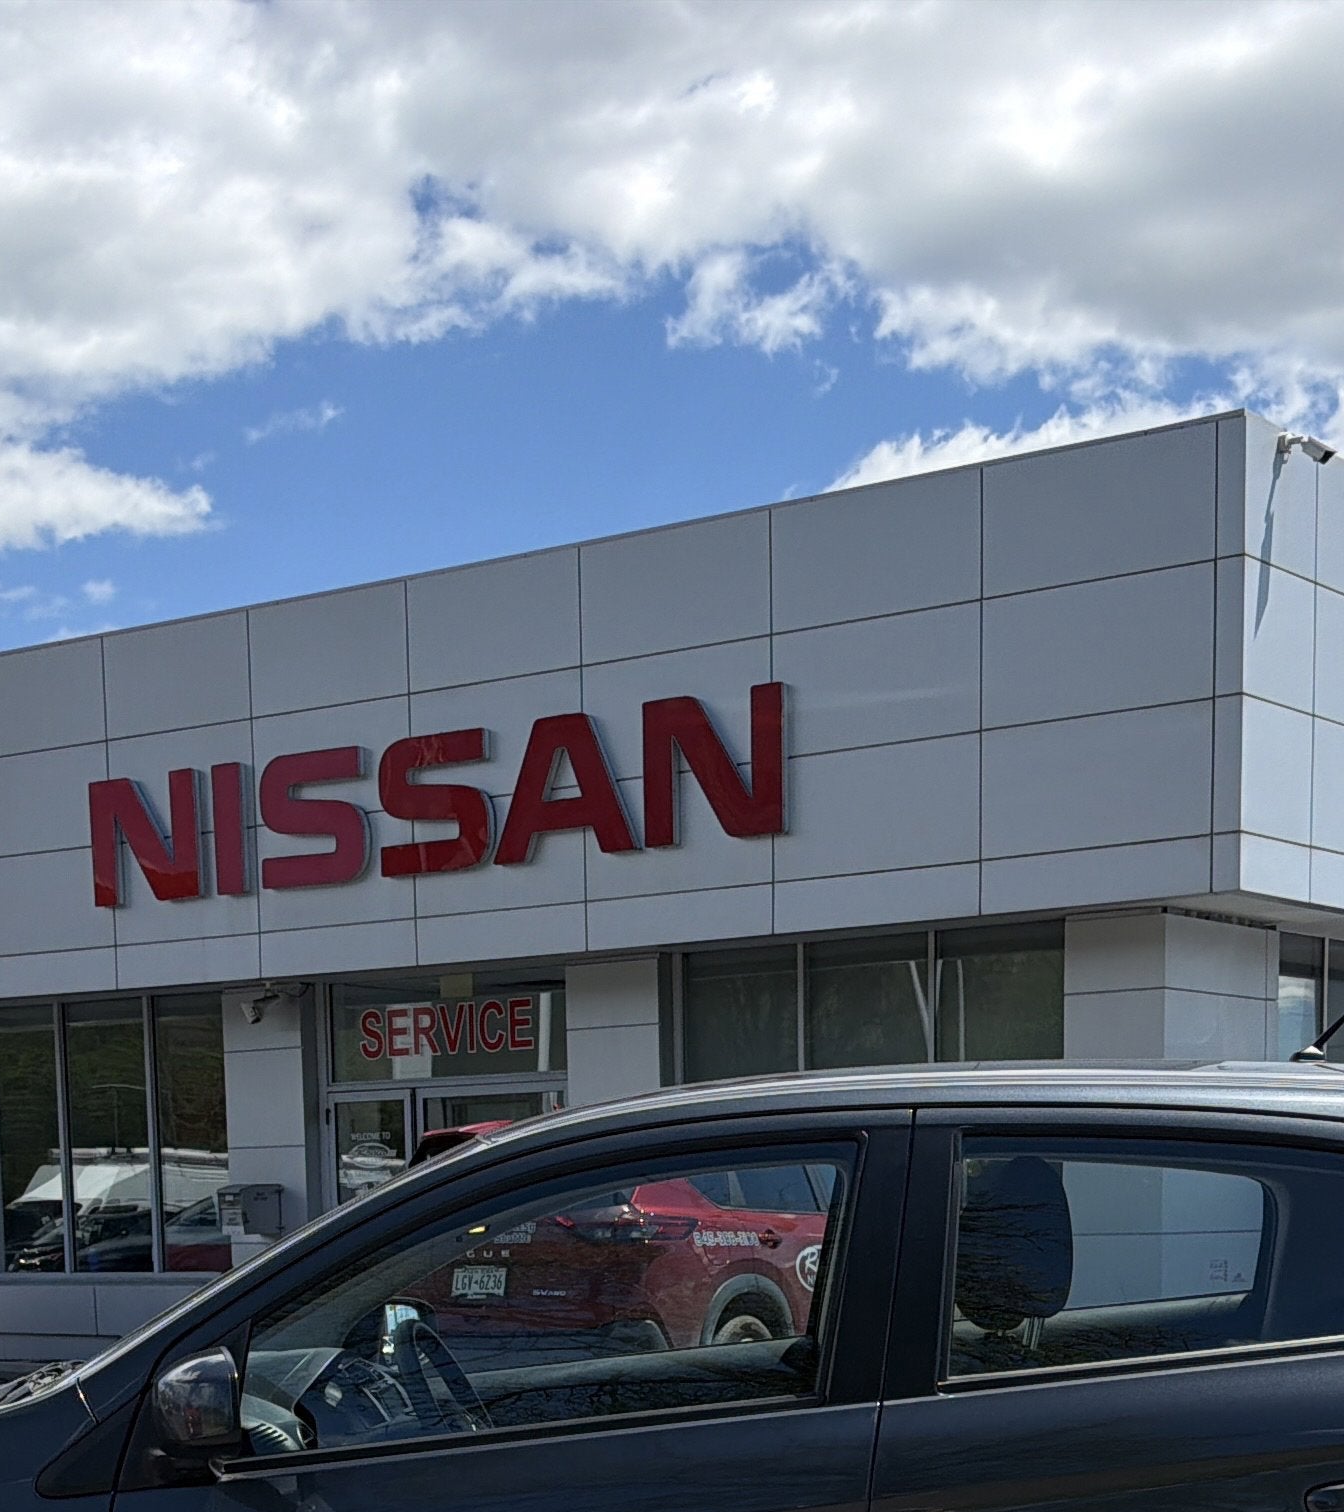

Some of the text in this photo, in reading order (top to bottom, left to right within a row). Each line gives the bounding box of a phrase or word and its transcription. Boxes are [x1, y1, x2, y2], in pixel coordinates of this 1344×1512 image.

[88, 681, 788, 908] NISSAN
[360, 997, 535, 1060] SERVICE
[350, 1131, 392, 1141] WELCOME TO
